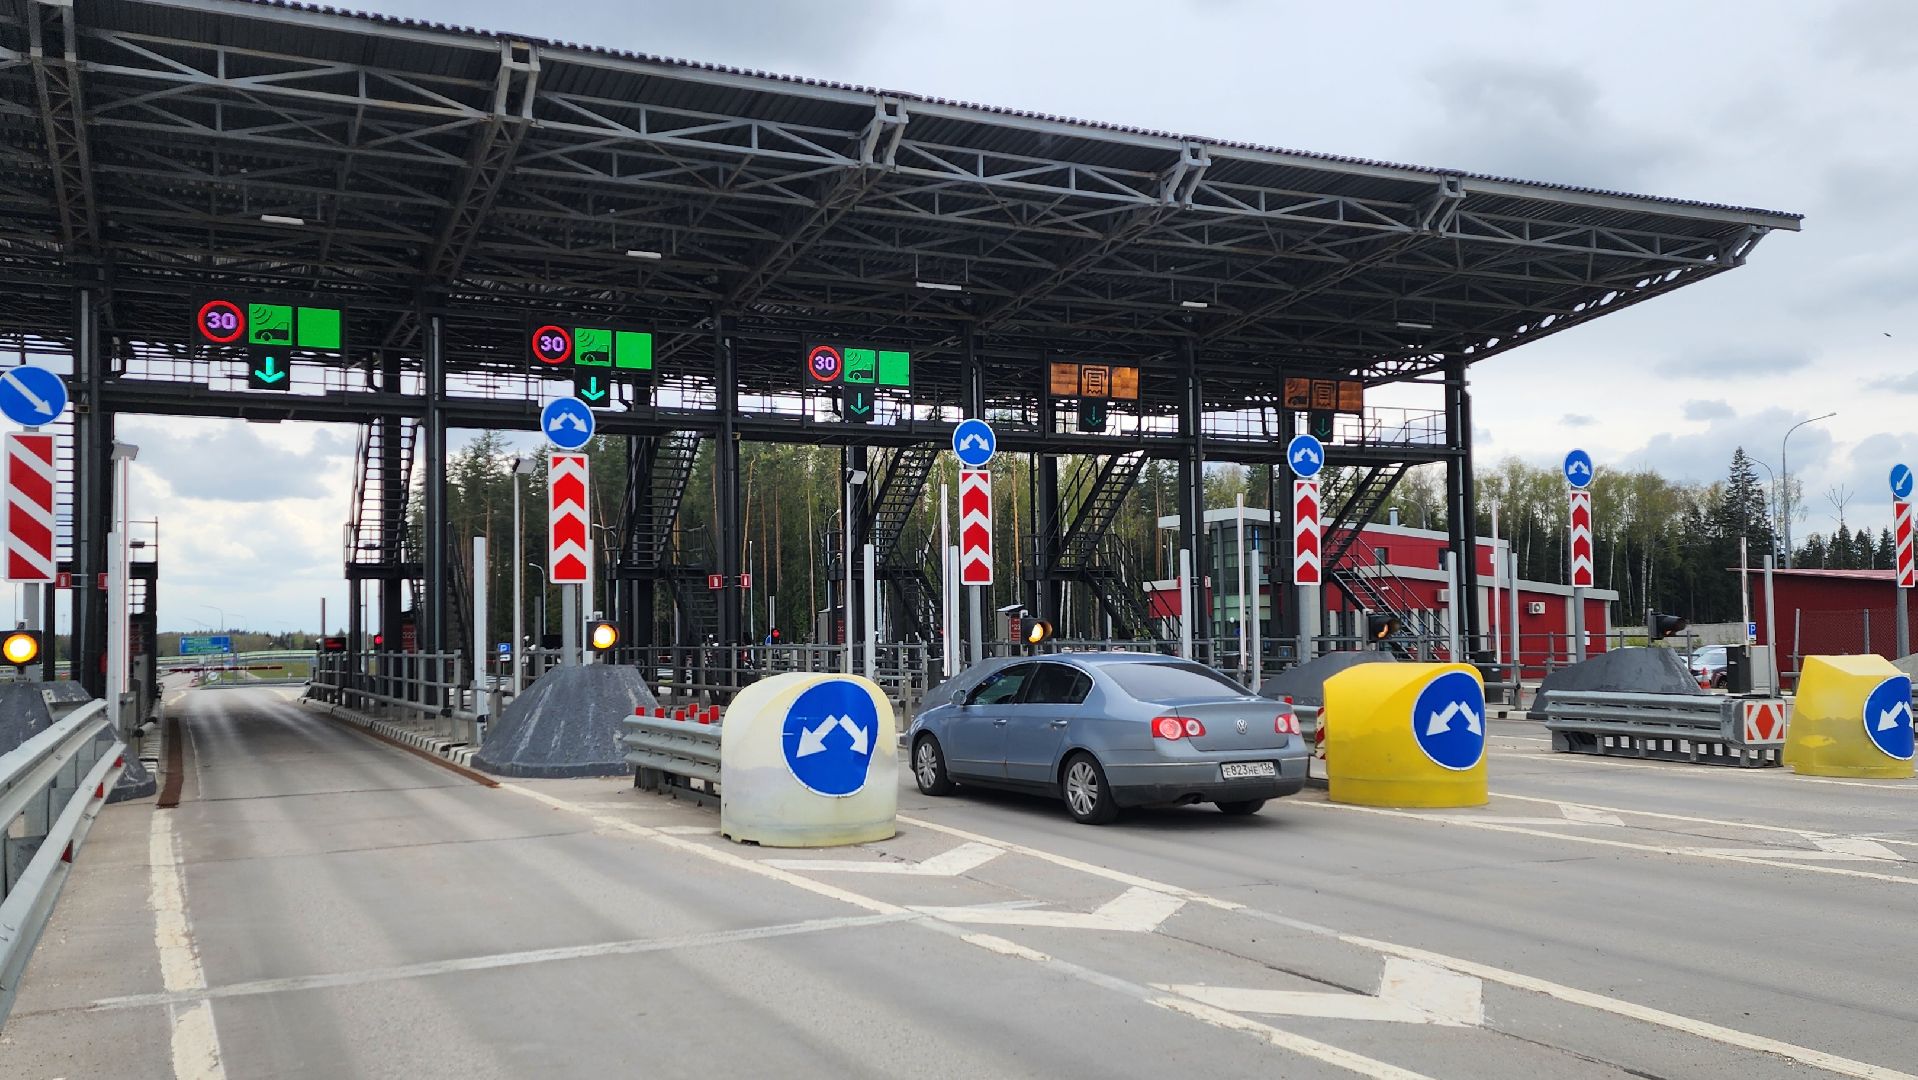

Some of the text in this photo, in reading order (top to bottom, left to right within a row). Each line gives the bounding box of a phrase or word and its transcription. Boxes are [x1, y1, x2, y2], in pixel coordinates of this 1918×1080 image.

[206, 311, 237, 330] 30
[540, 335, 565, 352] 30
[814, 355, 835, 371] 30
